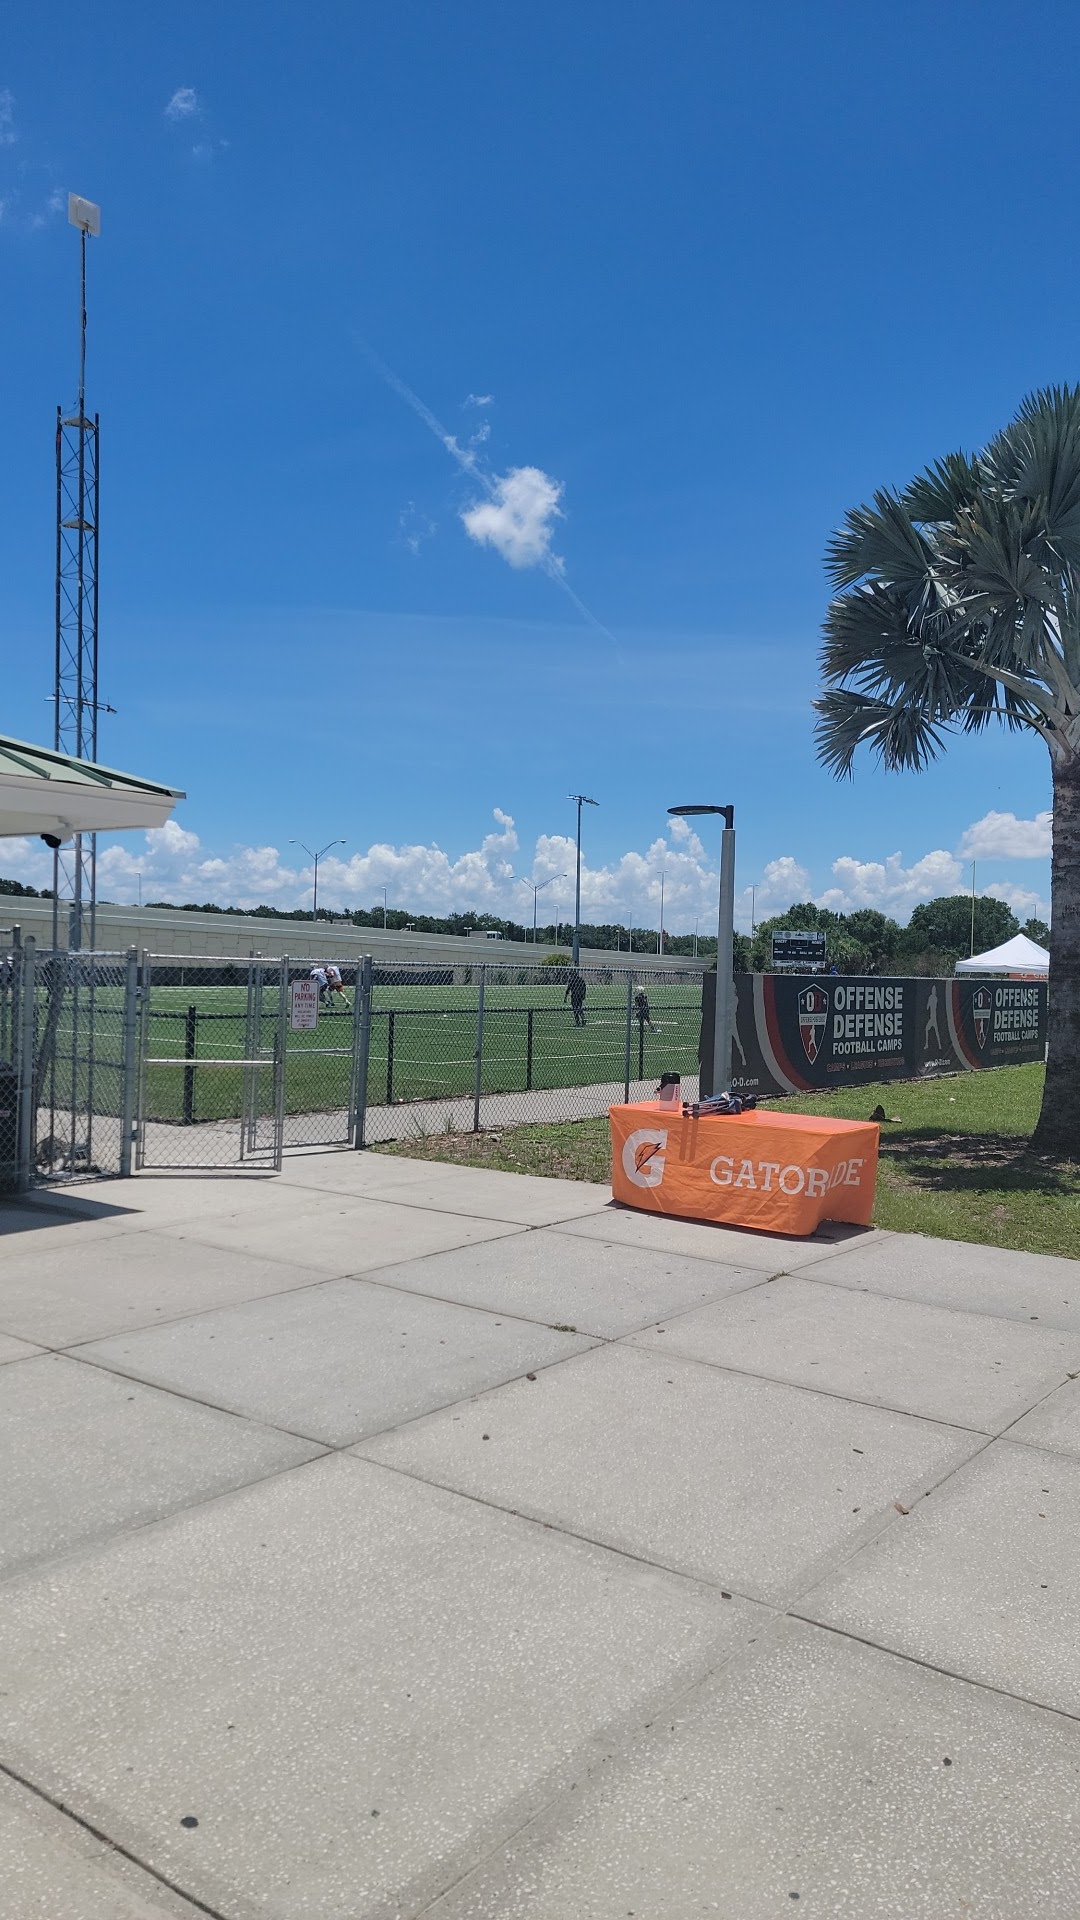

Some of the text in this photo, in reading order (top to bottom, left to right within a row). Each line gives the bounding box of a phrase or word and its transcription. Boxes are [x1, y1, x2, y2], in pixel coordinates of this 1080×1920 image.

[301, 983, 310, 991] NO
[295, 993, 315, 1001] PARKING
[834, 986, 903, 1010] OFFENSE
[995, 988, 1039, 1007] OFFENSE
[833, 1013, 903, 1039] DEFENSE
[994, 1009, 1039, 1029] DEFENSE
[993, 1029, 1039, 1042] FOOTBALL CAMPS
[832, 1038, 902, 1055] FOOTBALL CAMPS
[622, 1128, 668, 1188] G
